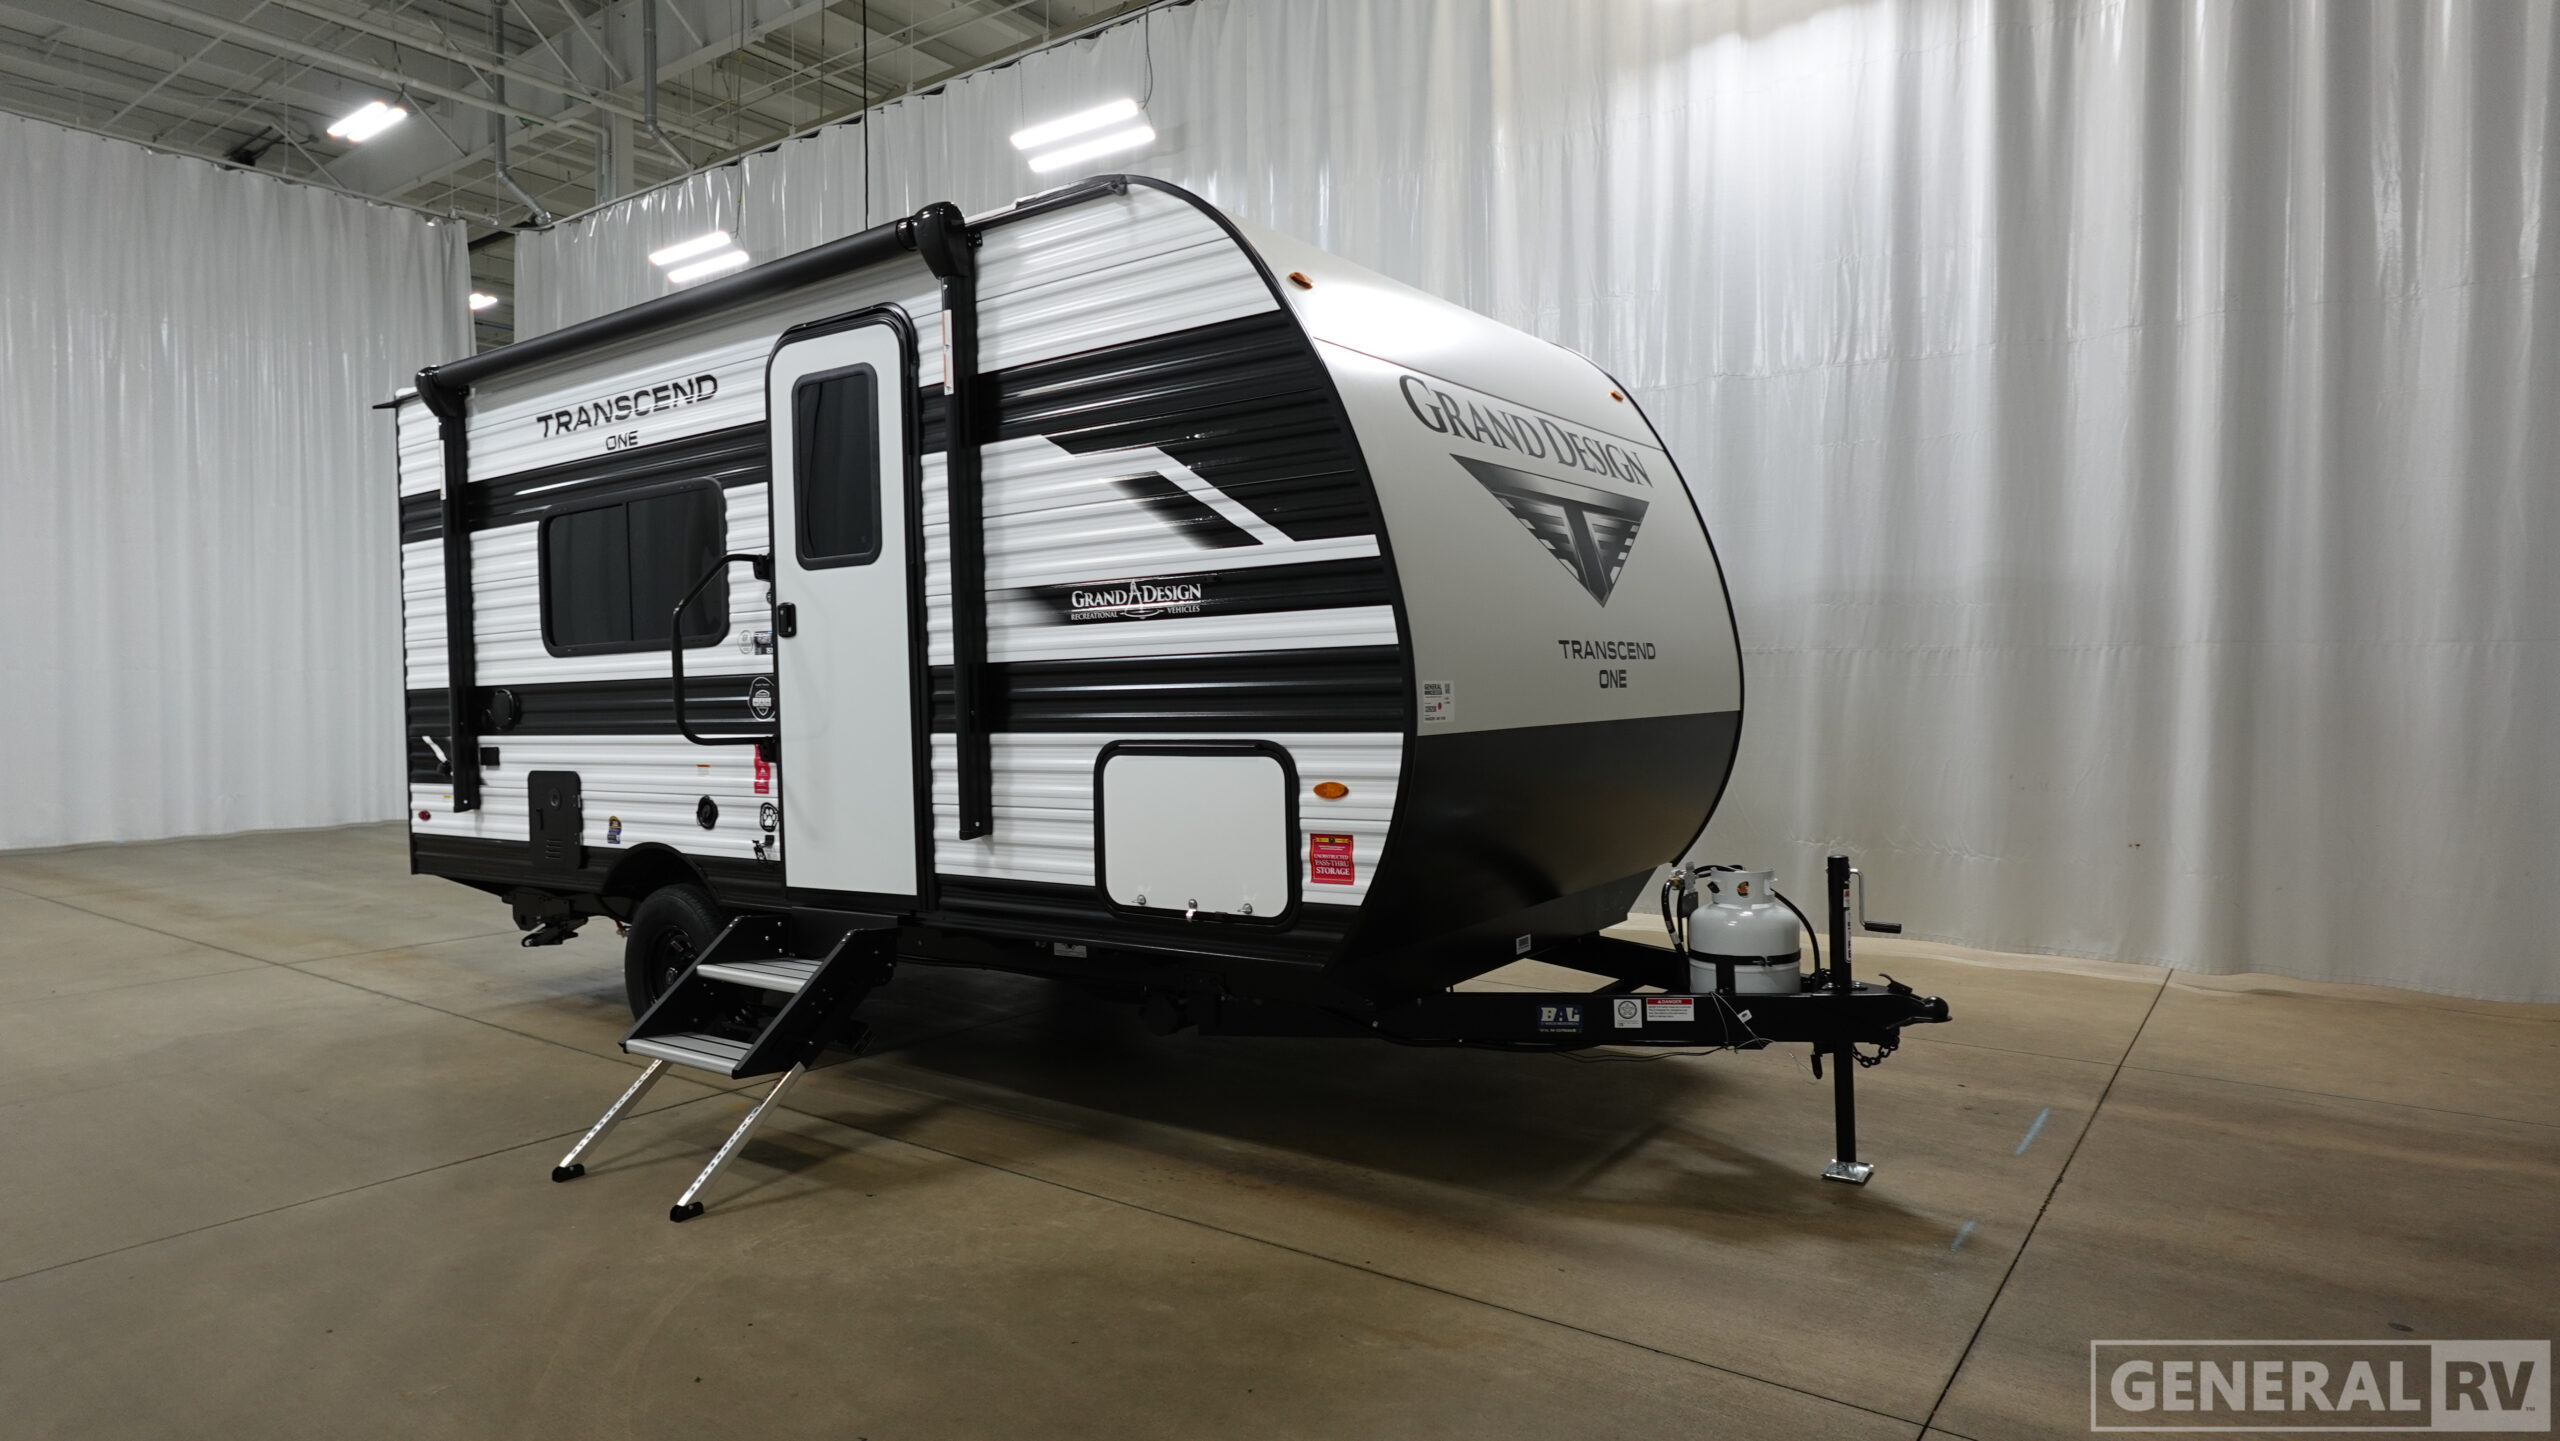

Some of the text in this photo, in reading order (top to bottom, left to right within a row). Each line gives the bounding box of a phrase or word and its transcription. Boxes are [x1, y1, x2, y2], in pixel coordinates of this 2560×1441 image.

[536, 374, 718, 438] TRANSCEND
[605, 430, 639, 450] ONE
[1071, 605, 1201, 621] RECREATIONAL VEHICLES
[1558, 639, 1656, 660] TRANSCEND
[1599, 669, 1627, 689] ONE
[1316, 866, 1351, 876] STORAGE
[1540, 1007, 1581, 1022] BAL
